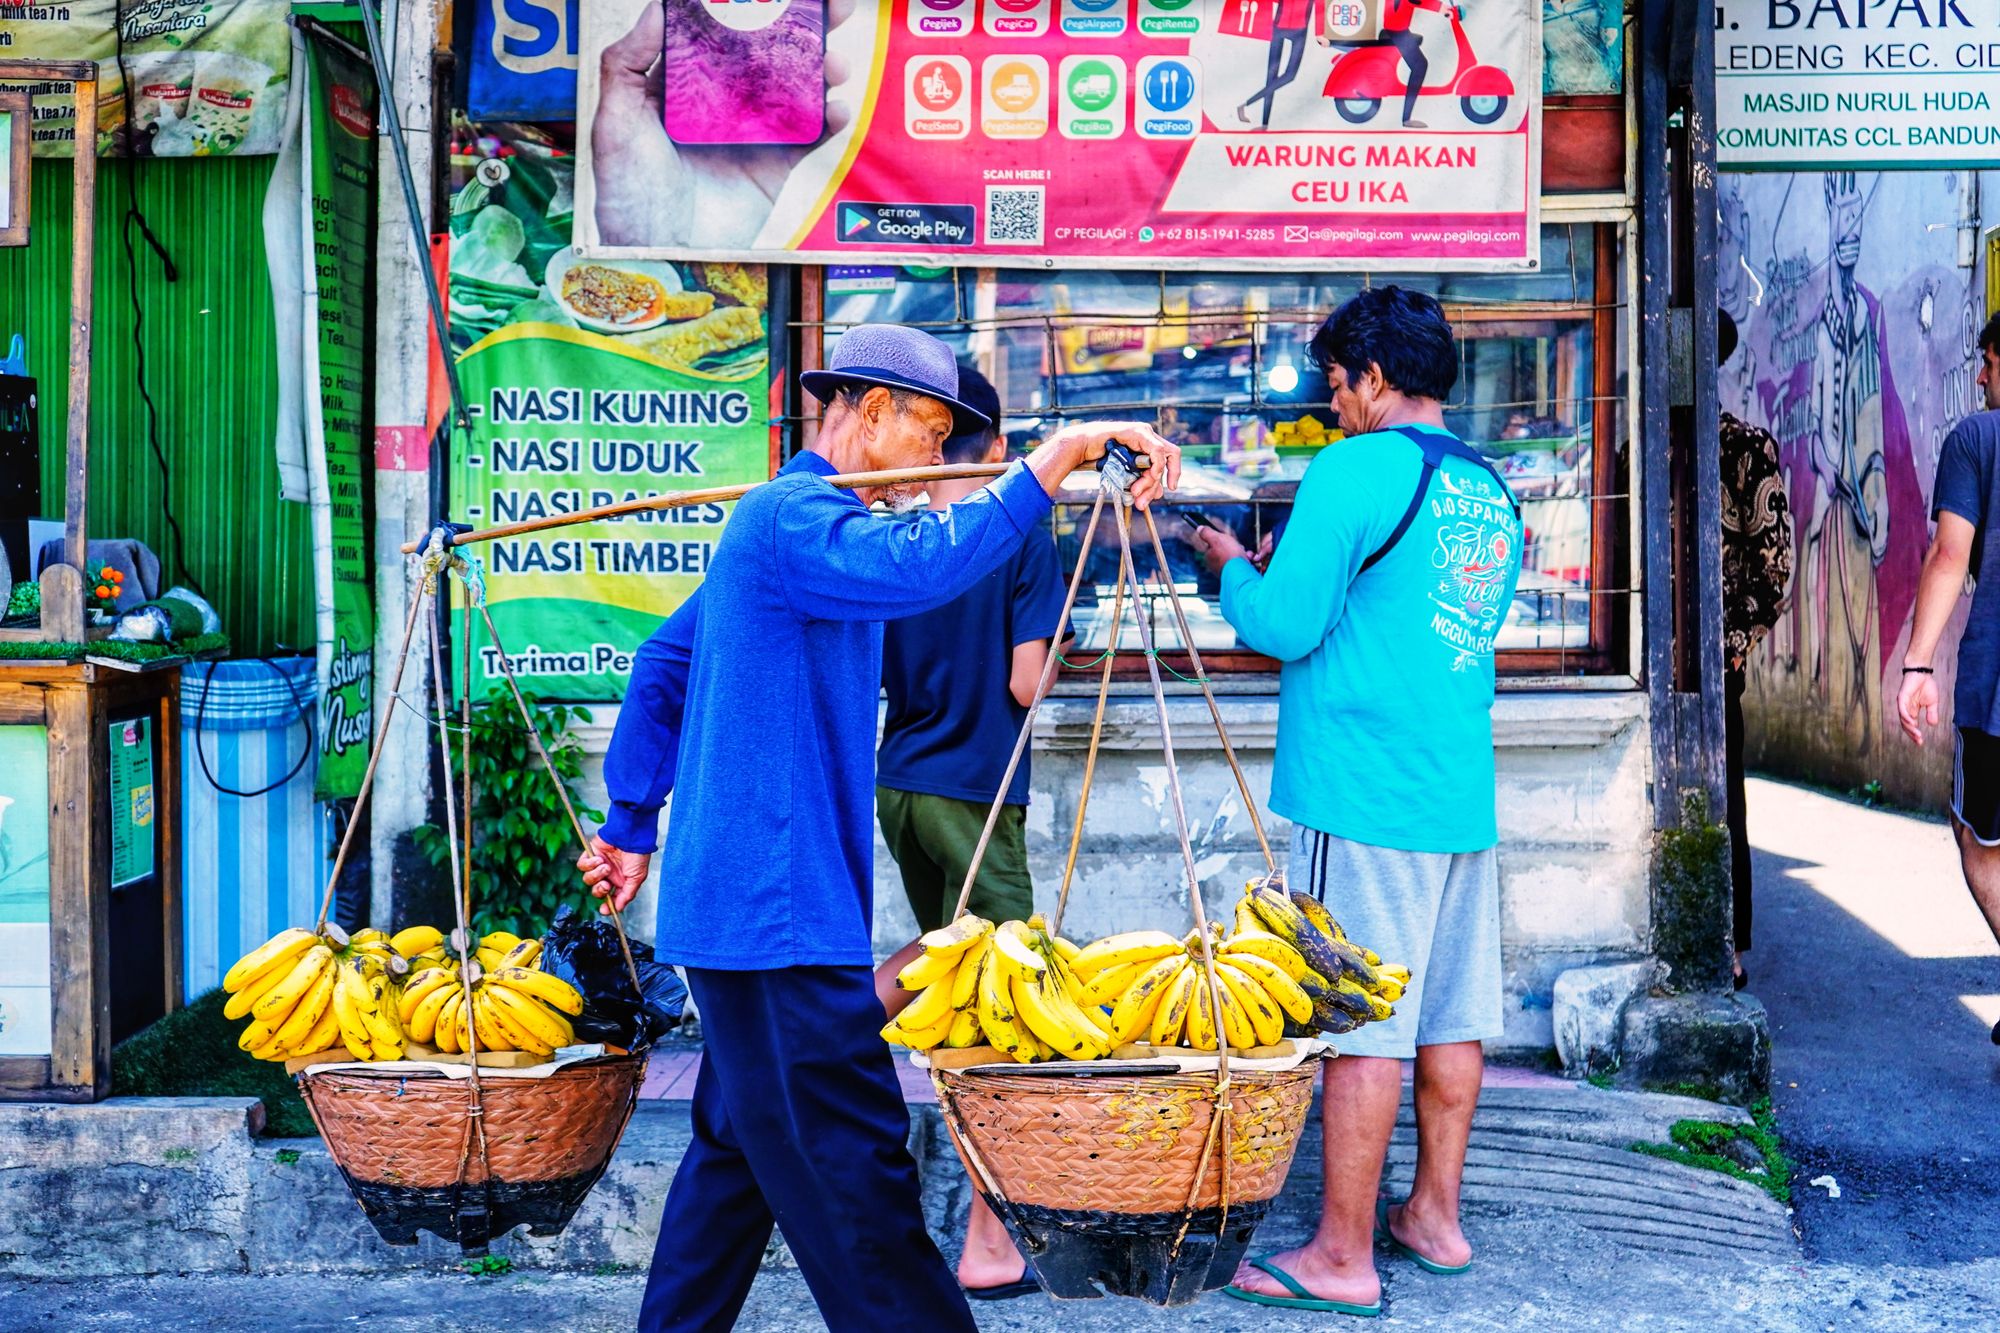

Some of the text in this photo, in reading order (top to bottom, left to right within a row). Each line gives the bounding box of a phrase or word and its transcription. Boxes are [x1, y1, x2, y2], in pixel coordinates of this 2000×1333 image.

[29, 6, 47, 20] tea
[49, 6, 55, 20] 7
[57, 6, 70, 20] rb
[1767, 0, 1975, 30] BAPAK
[121, 12, 206, 42] Nusantara
[998, 19, 1035, 30] PegiCar
[1066, 19, 1121, 31] PegiAirport
[1145, 19, 1197, 29] PegiRental
[0, 31, 12, 45] rb
[1865, 43, 1938, 68] KEC.
[54, 82, 71, 94] tea
[1744, 91, 1990, 112] MASJID NURUL HUDA
[42, 106, 59, 120] tea
[37, 129, 56, 141] tea
[916, 121, 960, 133] PegiSend
[1073, 121, 1111, 133] PegiBox
[1147, 121, 1191, 133] PegiFood
[1855, 127, 1902, 147] CCL
[1226, 145, 1476, 168] WARUNG MAKAN
[983, 169, 1013, 180] SCAN
[1015, 170, 1045, 180] HERE
[1291, 181, 1409, 203] CEU IKA
[877, 208, 895, 218] GET
[906, 209, 920, 218] ON
[876, 219, 966, 240] Google Play
[1054, 227, 1071, 239] CP
[1073, 227, 1127, 239] PEGILAGI
[1157, 228, 1181, 240] +62
[1185, 228, 1275, 241] 815-1941-5285
[1309, 228, 1404, 243] cs@pegilagi.com
[1411, 230, 1520, 243] www.pegilagi.com
[493, 390, 580, 421] NASI
[593, 391, 749, 423] KUNING
[493, 441, 579, 472] NASI
[593, 442, 700, 473] UDUK
[493, 491, 580, 522] NASI
[493, 541, 582, 572] NASI
[482, 647, 636, 674] Terima Pe
